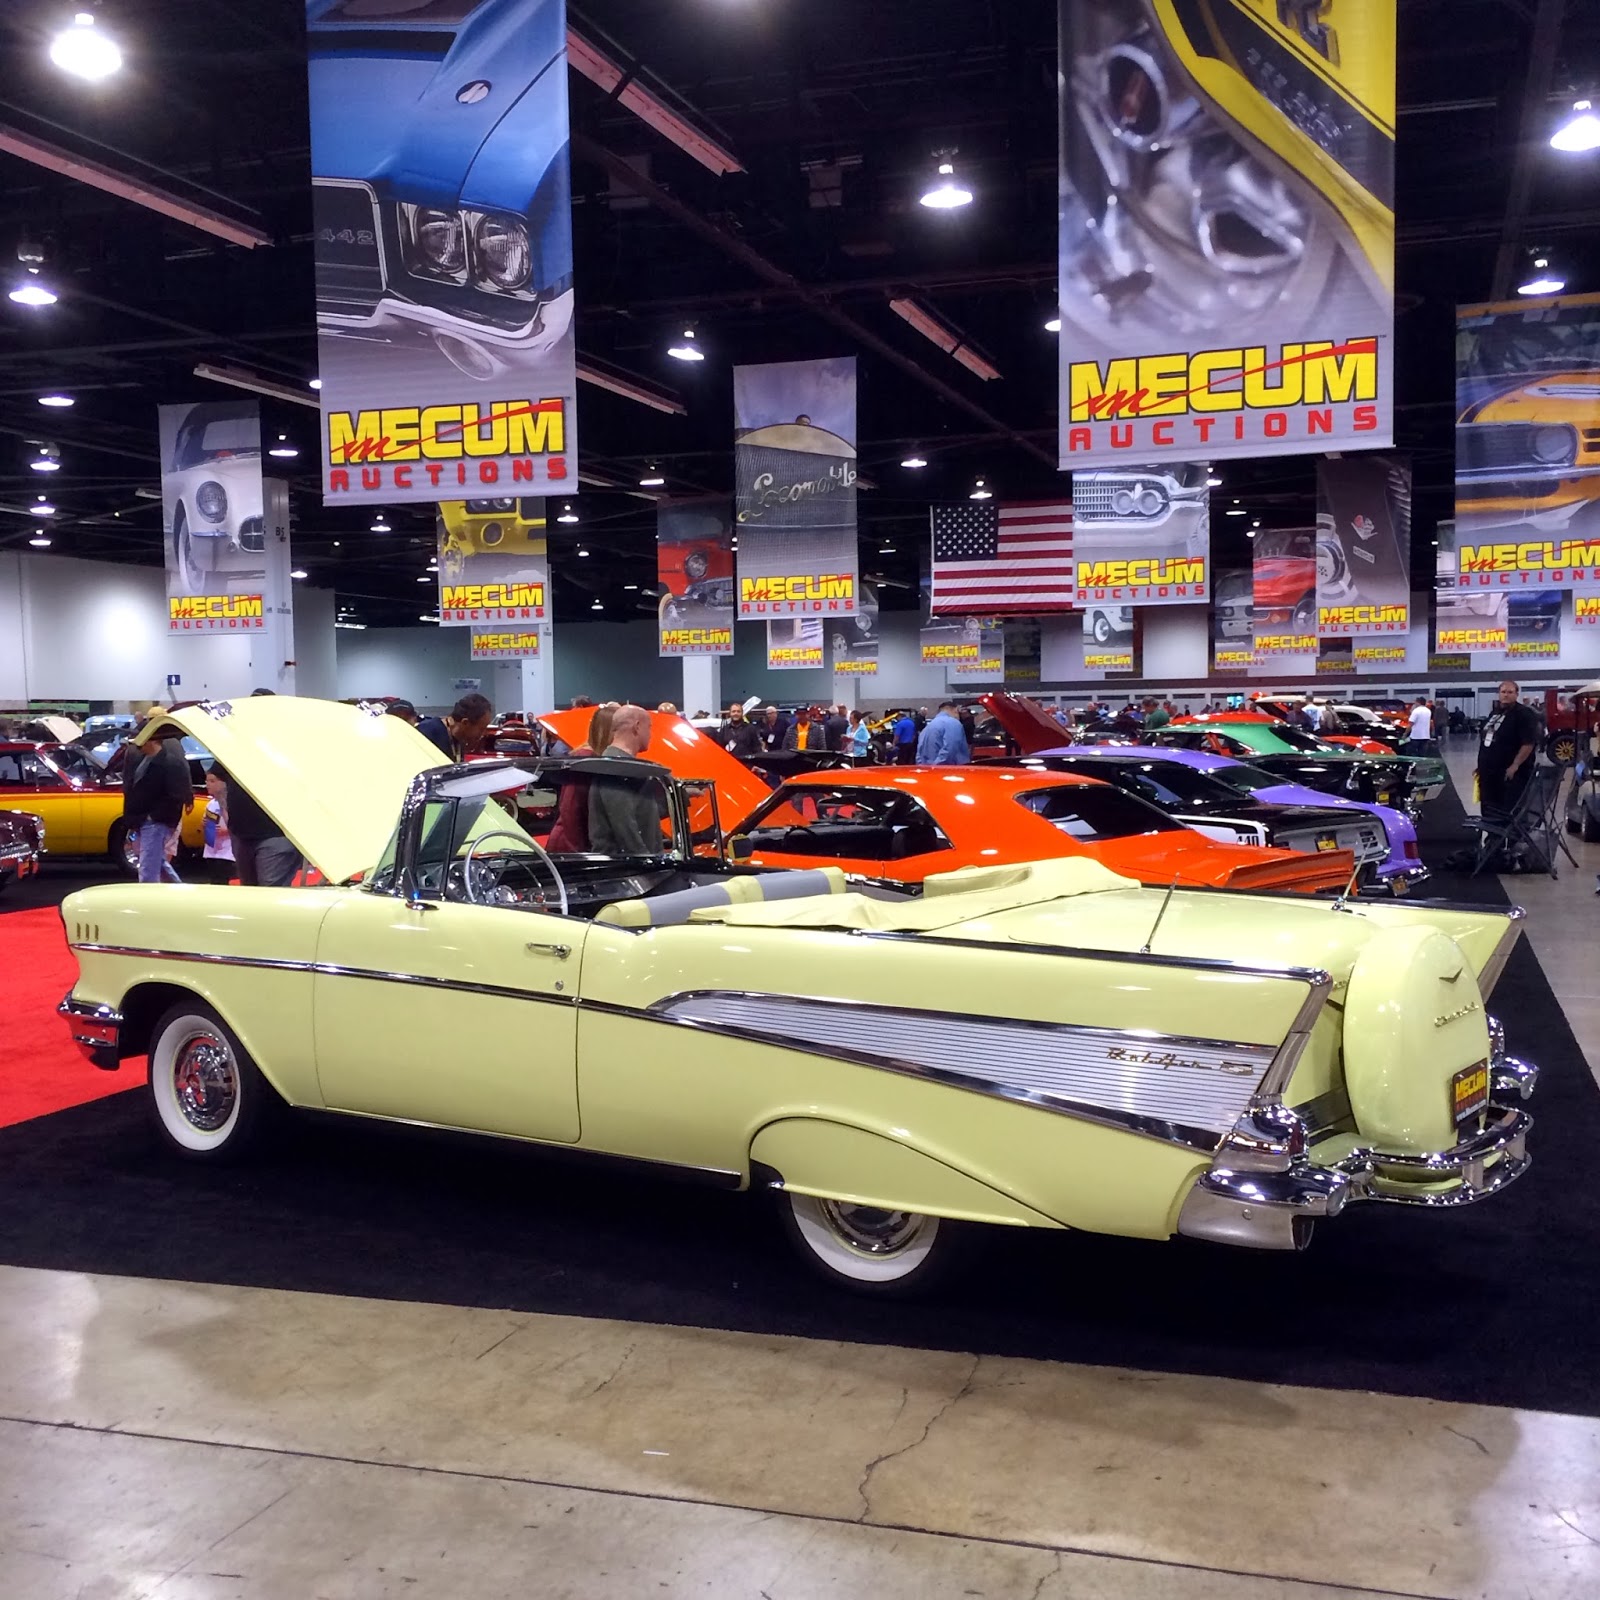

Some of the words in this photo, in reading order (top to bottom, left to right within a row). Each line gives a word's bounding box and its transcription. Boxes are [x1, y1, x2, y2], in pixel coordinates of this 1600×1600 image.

[1068, 336, 1378, 424] MECUM
[328, 397, 566, 465] MECUM
[1069, 405, 1378, 451] AUCTIONS
[330, 457, 567, 491] AUCTIONS
[1459, 539, 1600, 574] MECUM
[1077, 557, 1205, 588] MECUM
[741, 573, 854, 602] MECUM
[1077, 585, 1205, 600] AUCTIONS
[442, 582, 544, 610] MECUM
[170, 594, 263, 619] MECUM
[442, 608, 544, 620] AUCTIONS
[741, 600, 854, 613] AUCTIONS
[1318, 604, 1407, 625] MECUM
[170, 619, 263, 629] AUCTIONS
[1318, 623, 1407, 632] AUCTIONS
[473, 633, 538, 649] MECUM
[662, 628, 731, 645] MECUM
[1255, 634, 1318, 649] MECUM
[1438, 628, 1506, 644] MECUM
[473, 648, 538, 657] AUCTIONS
[769, 647, 822, 661] MECUM
[922, 644, 978, 658] MECUM
[1354, 647, 1406, 659] MECUM
[1508, 642, 1559, 653] MECUM
[1084, 654, 1131, 666] MECUM
[1216, 652, 1264, 662] MECU
[834, 661, 877, 672] MECUM
